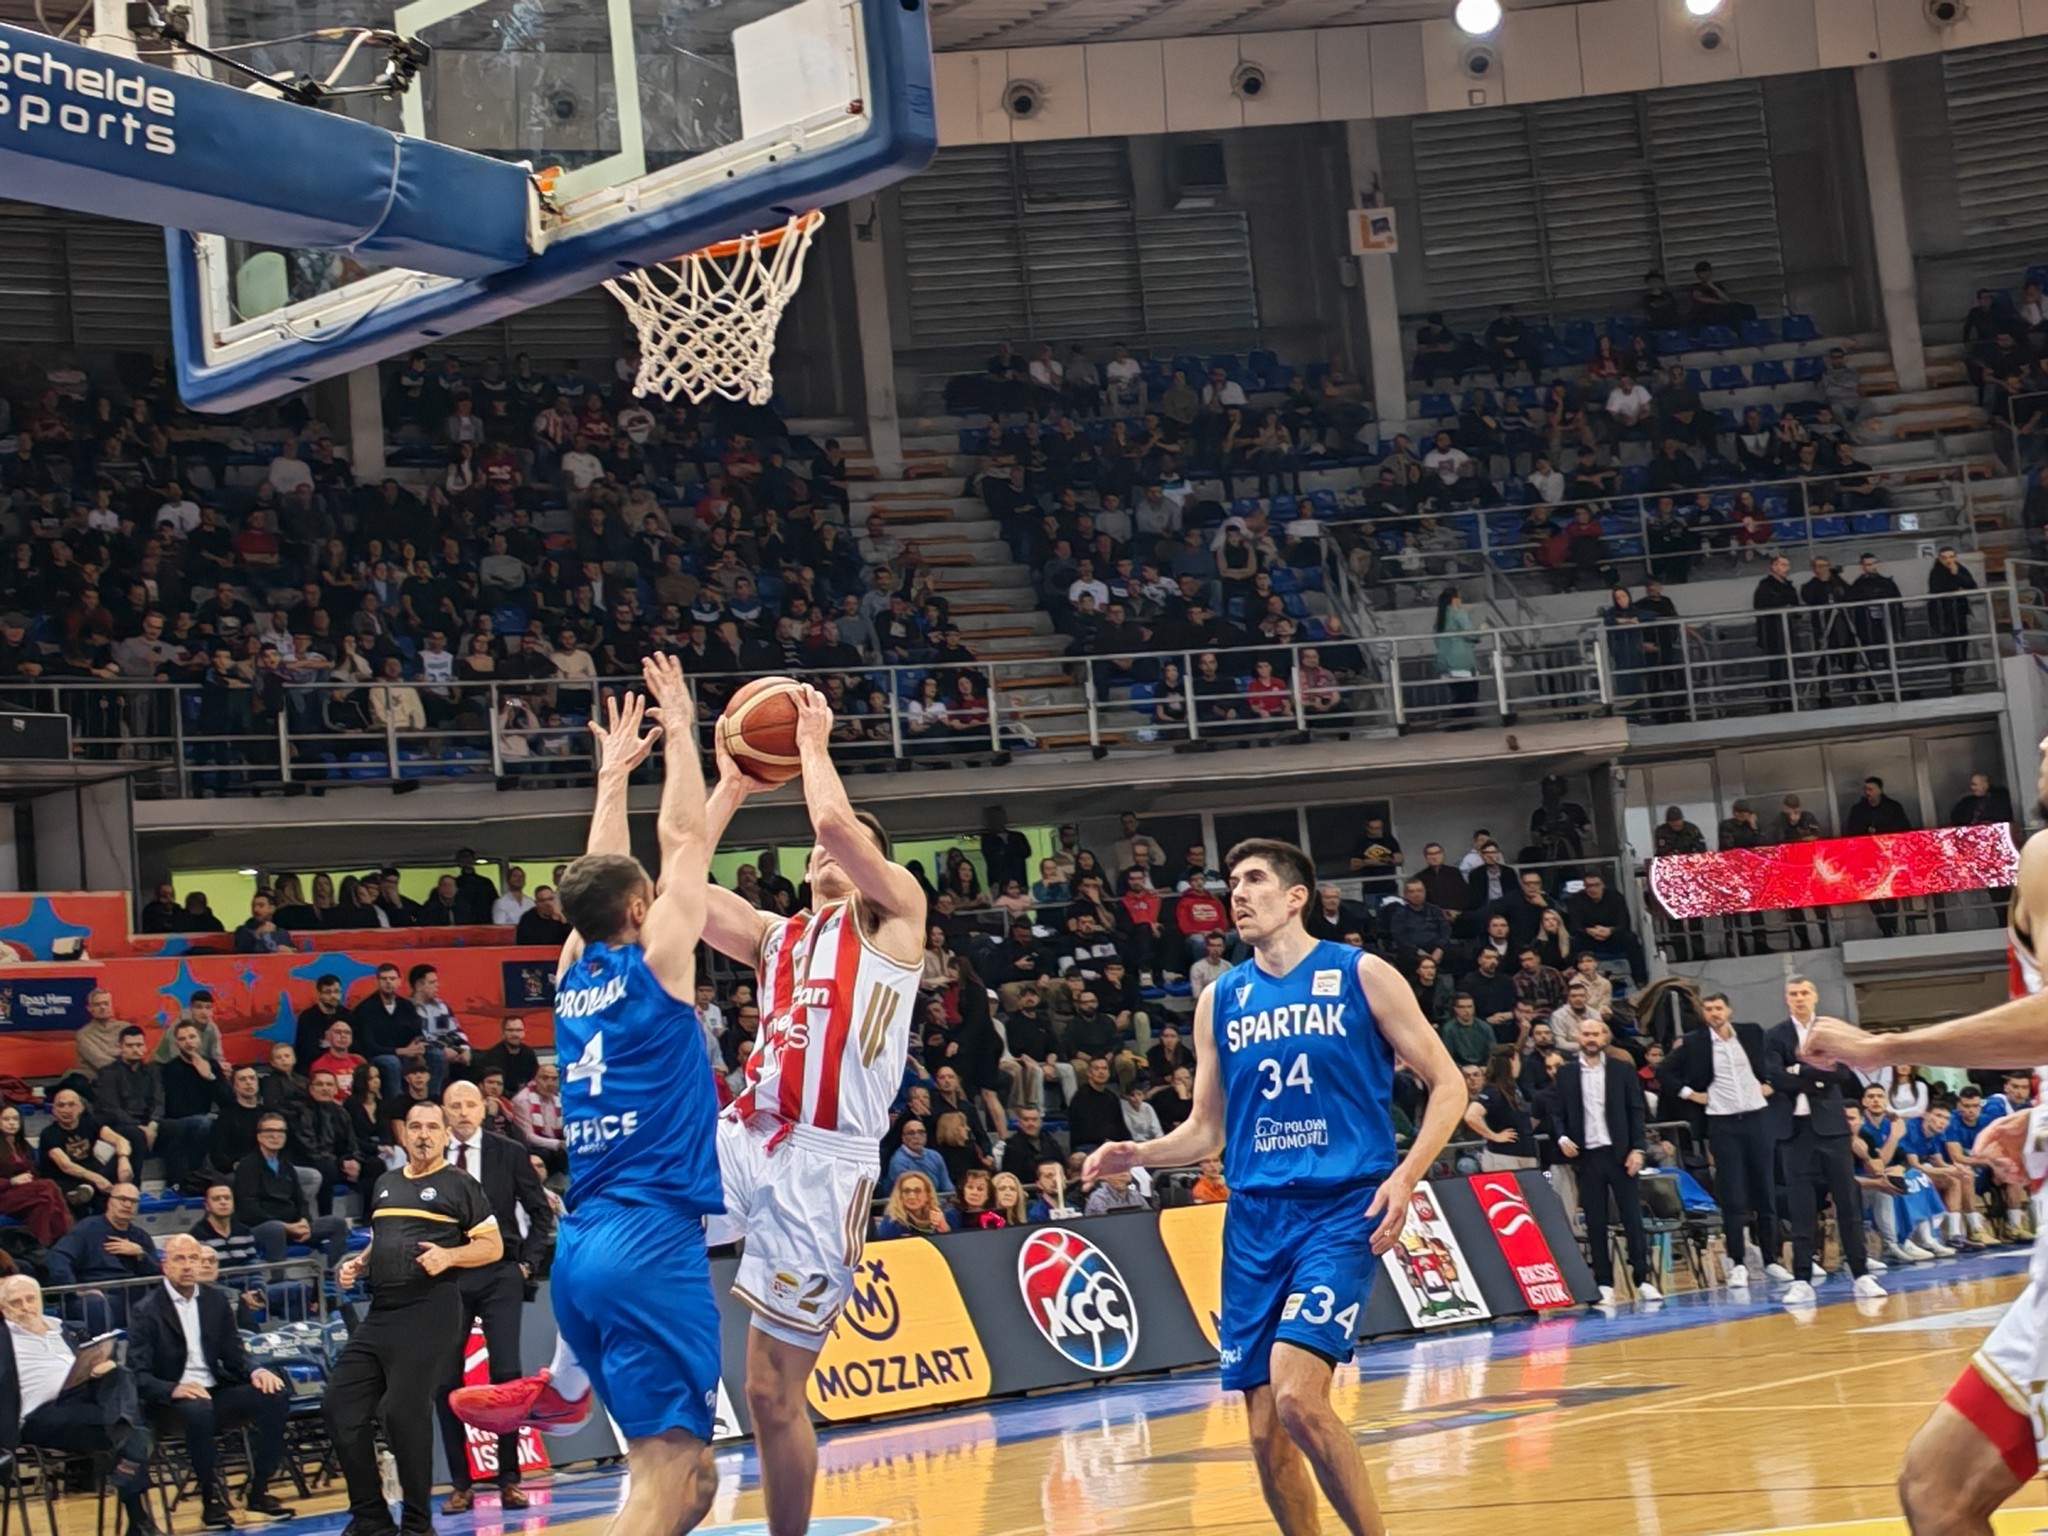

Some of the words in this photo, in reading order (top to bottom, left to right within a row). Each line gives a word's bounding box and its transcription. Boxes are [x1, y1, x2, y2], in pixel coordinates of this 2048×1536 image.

[1227, 1003, 1347, 1053] SPARTAK
[566, 1030, 607, 1096] 4
[1258, 1053, 1314, 1100] 34
[797, 1273, 829, 1314] 2
[1040, 1288, 1129, 1338] KCC
[1301, 1285, 1360, 1340] 34
[814, 1346, 973, 1403] MOZZART
